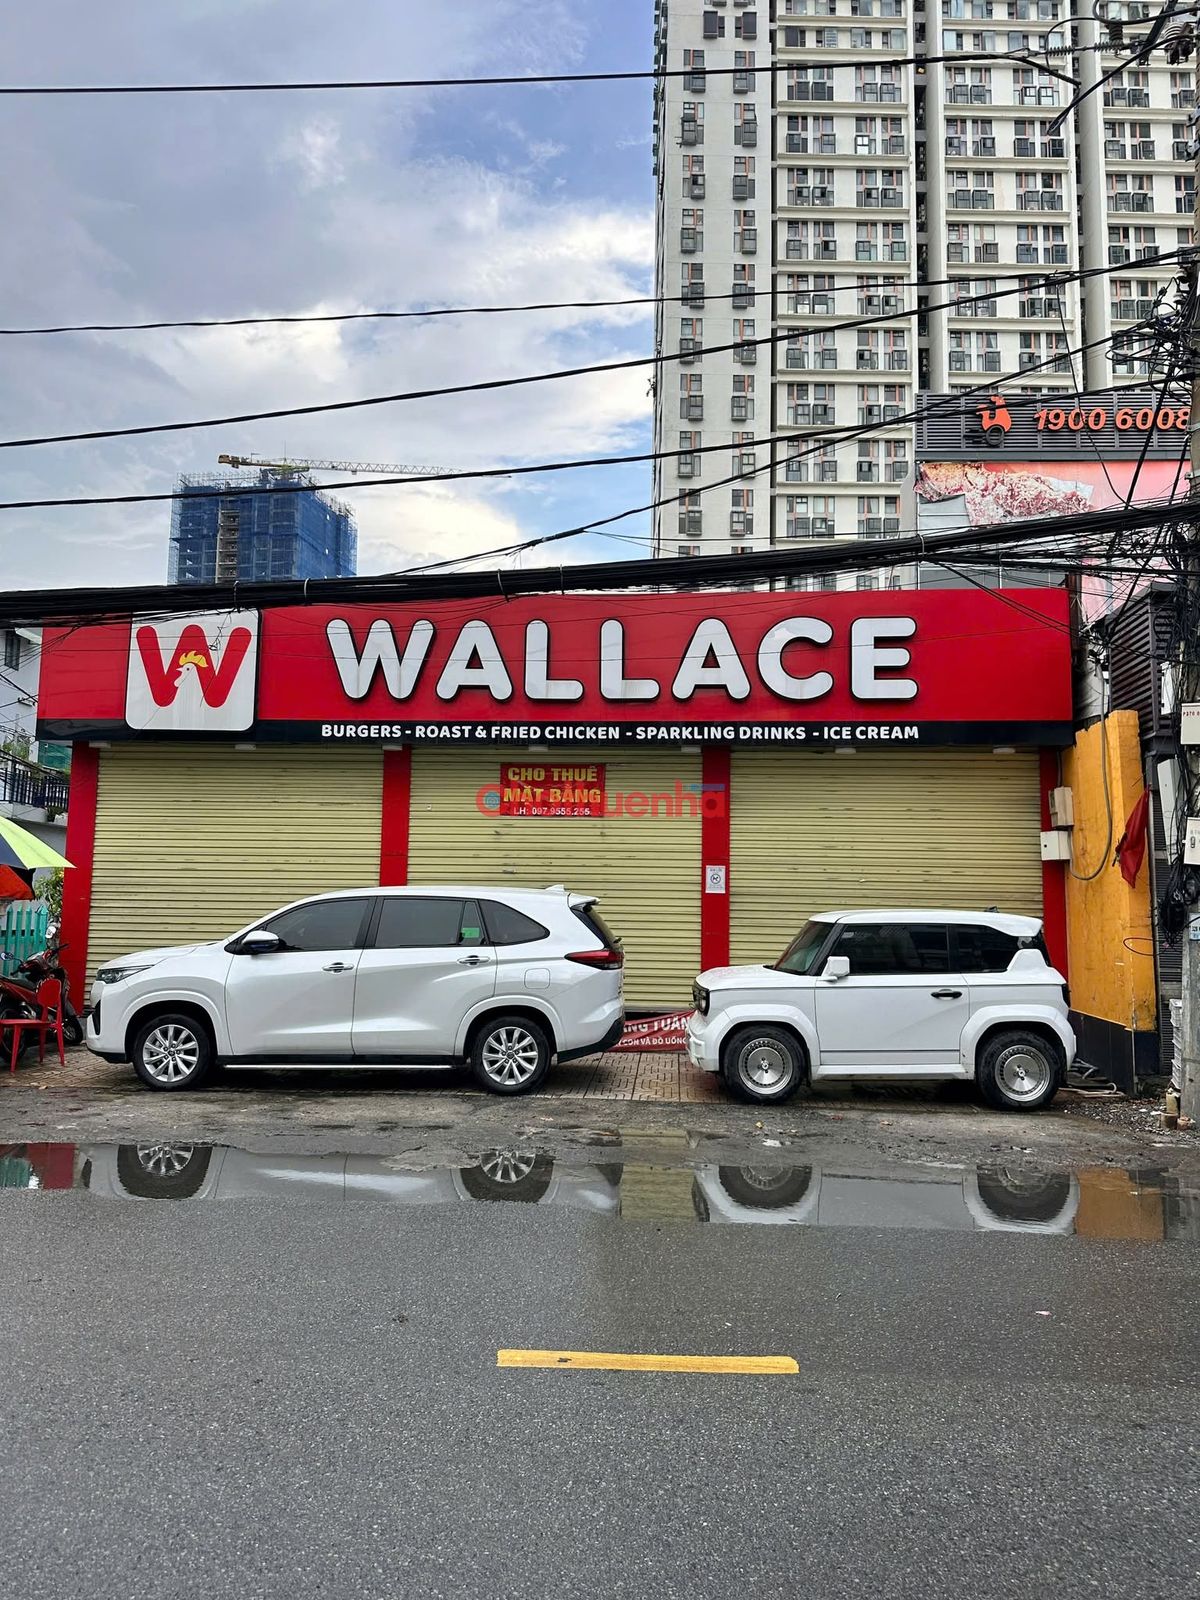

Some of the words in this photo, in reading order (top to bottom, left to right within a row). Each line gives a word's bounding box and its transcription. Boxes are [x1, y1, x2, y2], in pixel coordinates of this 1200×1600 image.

[1034, 408, 1106, 431] 1900
[1115, 407, 1191, 431] 6008
[326, 616, 919, 701] WALLACE
[321, 724, 402, 738] BURGERS
[415, 725, 472, 739] ROAST
[474, 725, 488, 739] &
[491, 726, 541, 739] FRIED
[544, 726, 621, 740] CHICKEN
[635, 726, 735, 740] SPARKLING
[738, 726, 806, 740] DRINKS
[823, 726, 852, 740] ICE
[855, 726, 919, 740] CREAM
[507, 767, 546, 782] CHO
[550, 765, 598, 782] THUÊ
[503, 785, 545, 804] MẶT
[513, 806, 530, 816] LH:
